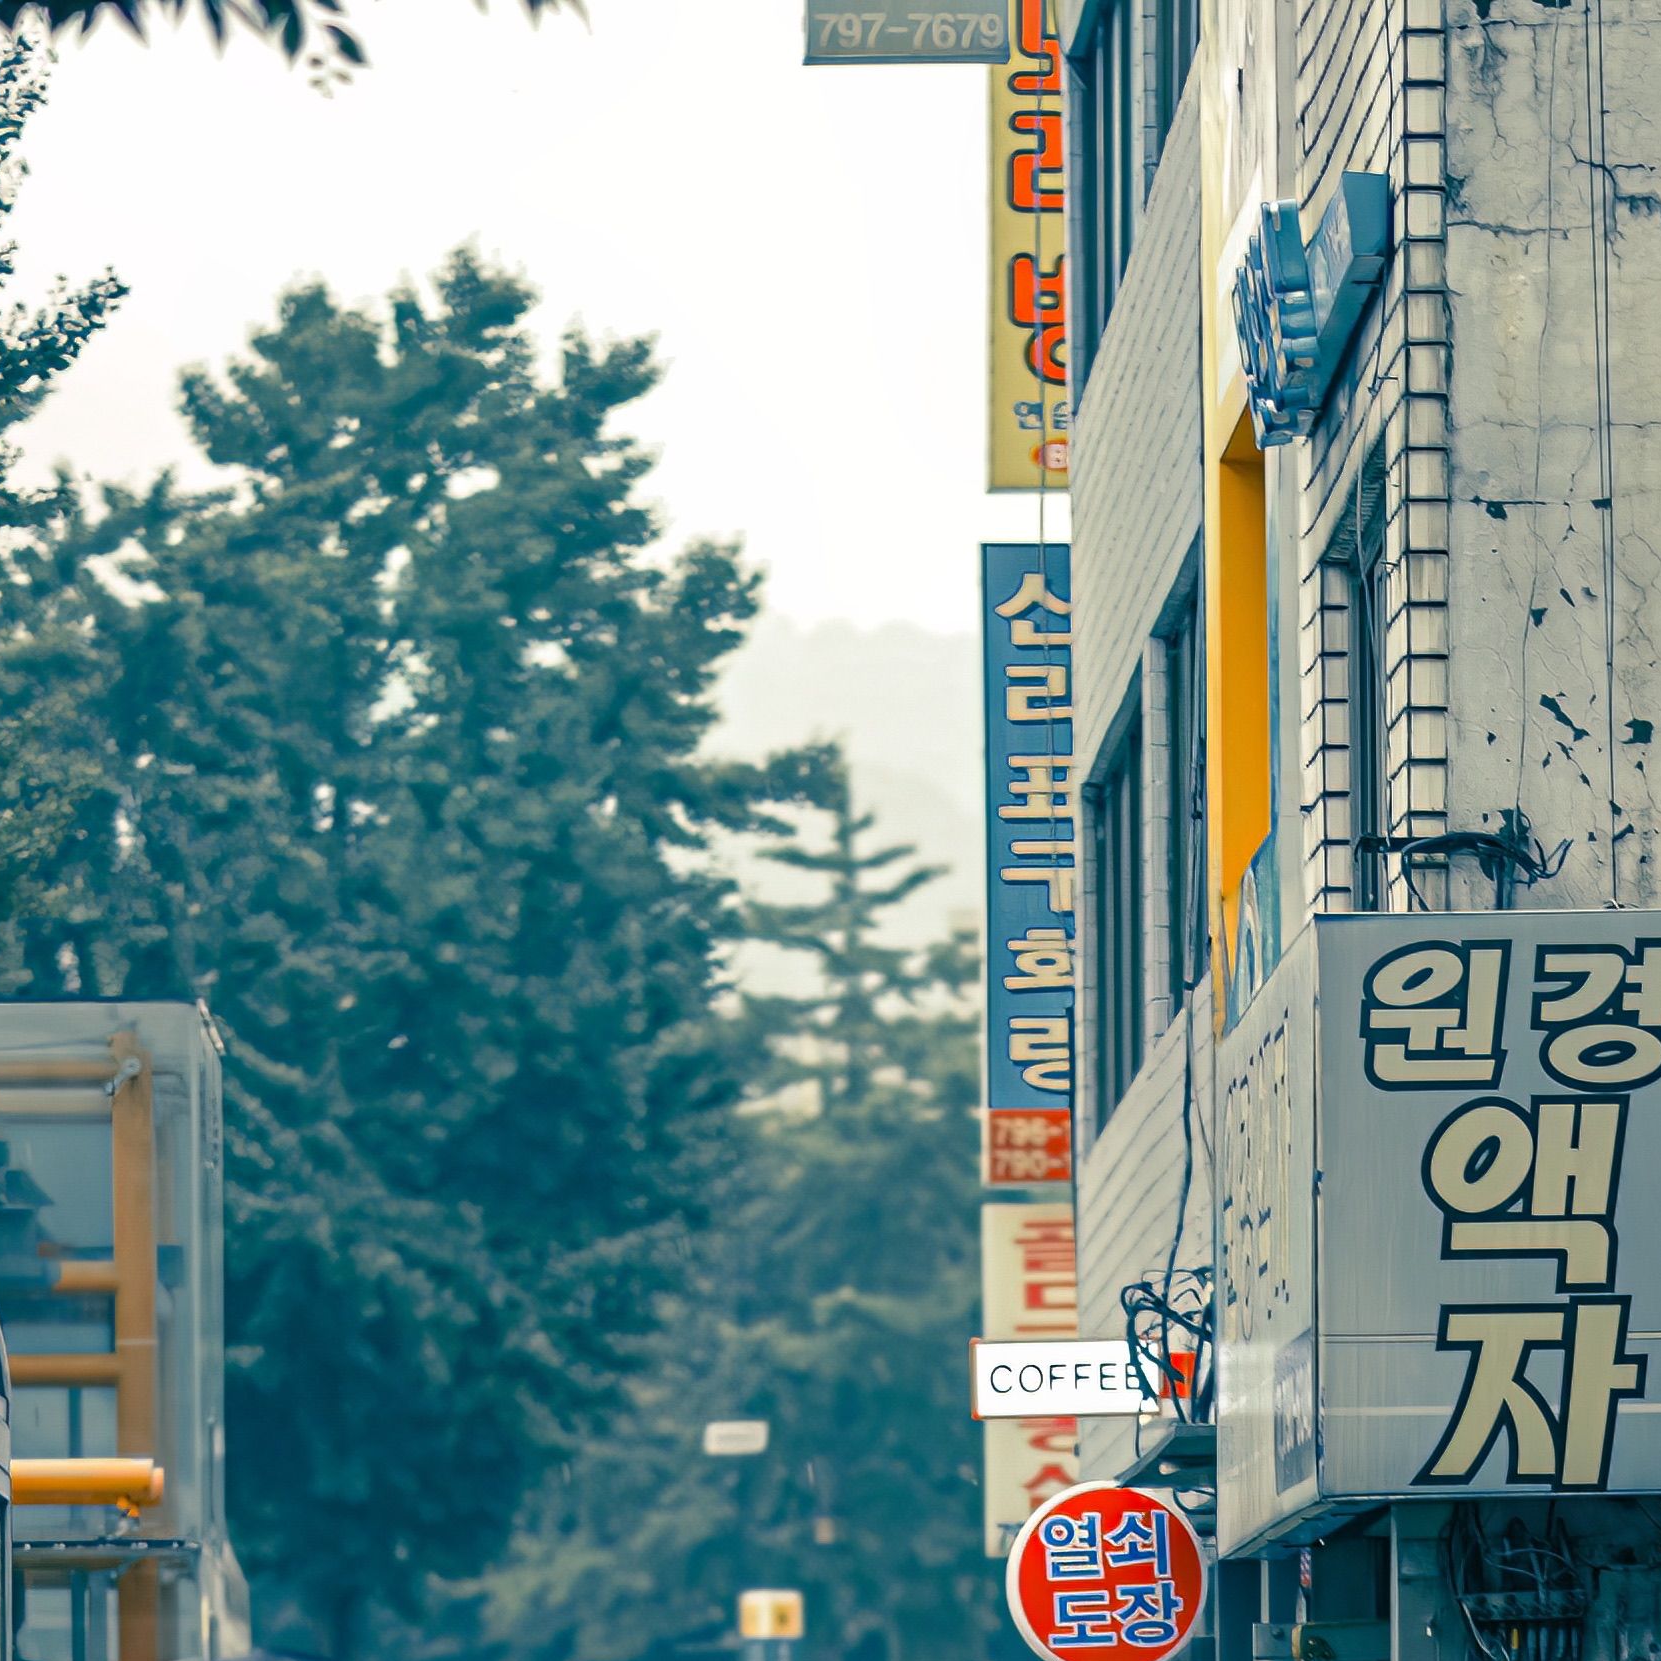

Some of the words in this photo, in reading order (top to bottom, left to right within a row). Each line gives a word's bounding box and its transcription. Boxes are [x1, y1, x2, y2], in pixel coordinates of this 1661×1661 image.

[813, 11, 1005, 49] 797-7679
[989, 1363, 1142, 1394] COFFEE
[1038, 1509, 1172, 1581] 열쇠
[1047, 1580, 1184, 1650] 도장
